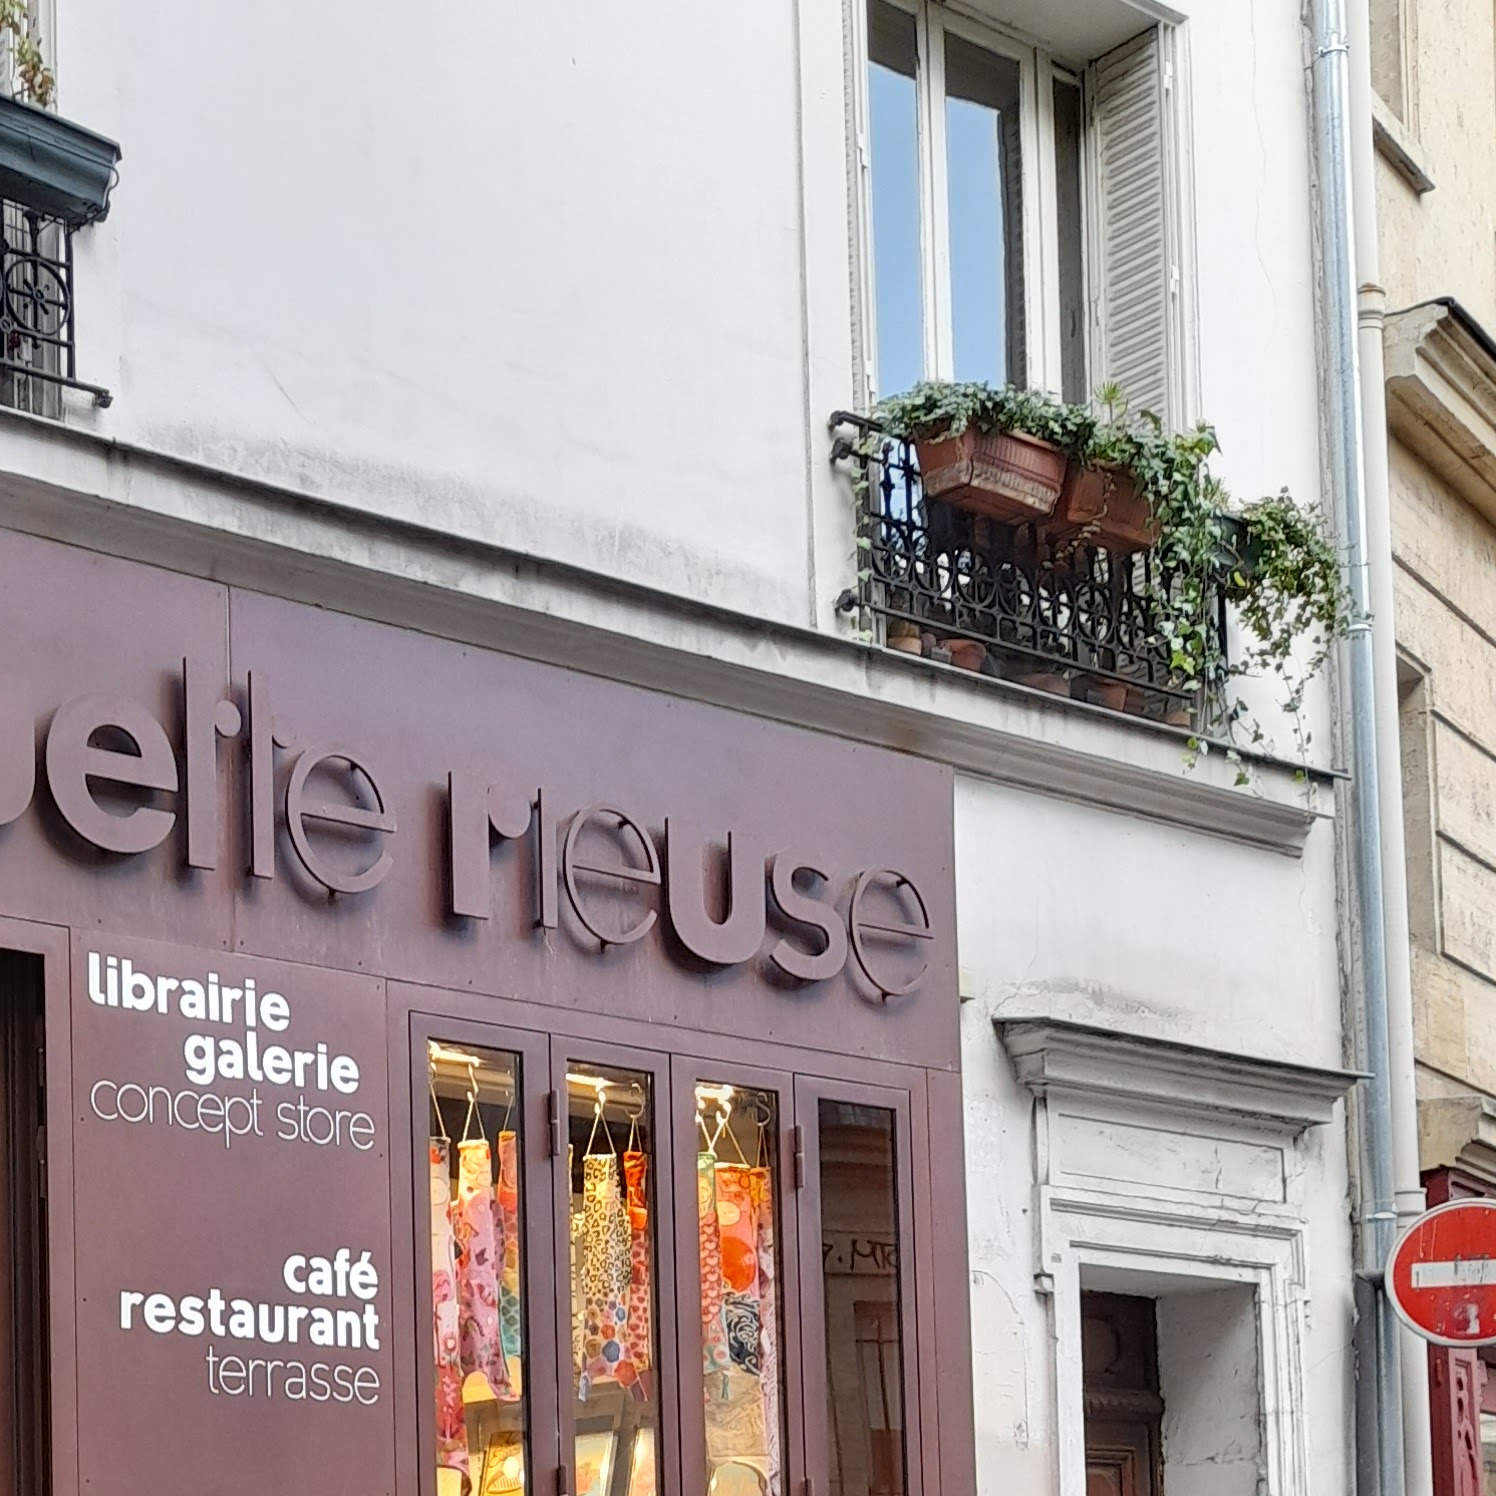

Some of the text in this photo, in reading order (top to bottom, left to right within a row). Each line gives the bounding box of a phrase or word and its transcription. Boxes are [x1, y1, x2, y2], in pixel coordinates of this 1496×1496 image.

[447, 771, 935, 998] rieuse
[87, 951, 291, 1032] librairie
[183, 1030, 360, 1094] galerie
[90, 1080, 376, 1151] concept store
[282, 1248, 380, 1300] café
[119, 1288, 381, 1350] restaurant
[204, 1344, 381, 1405] terrasse
